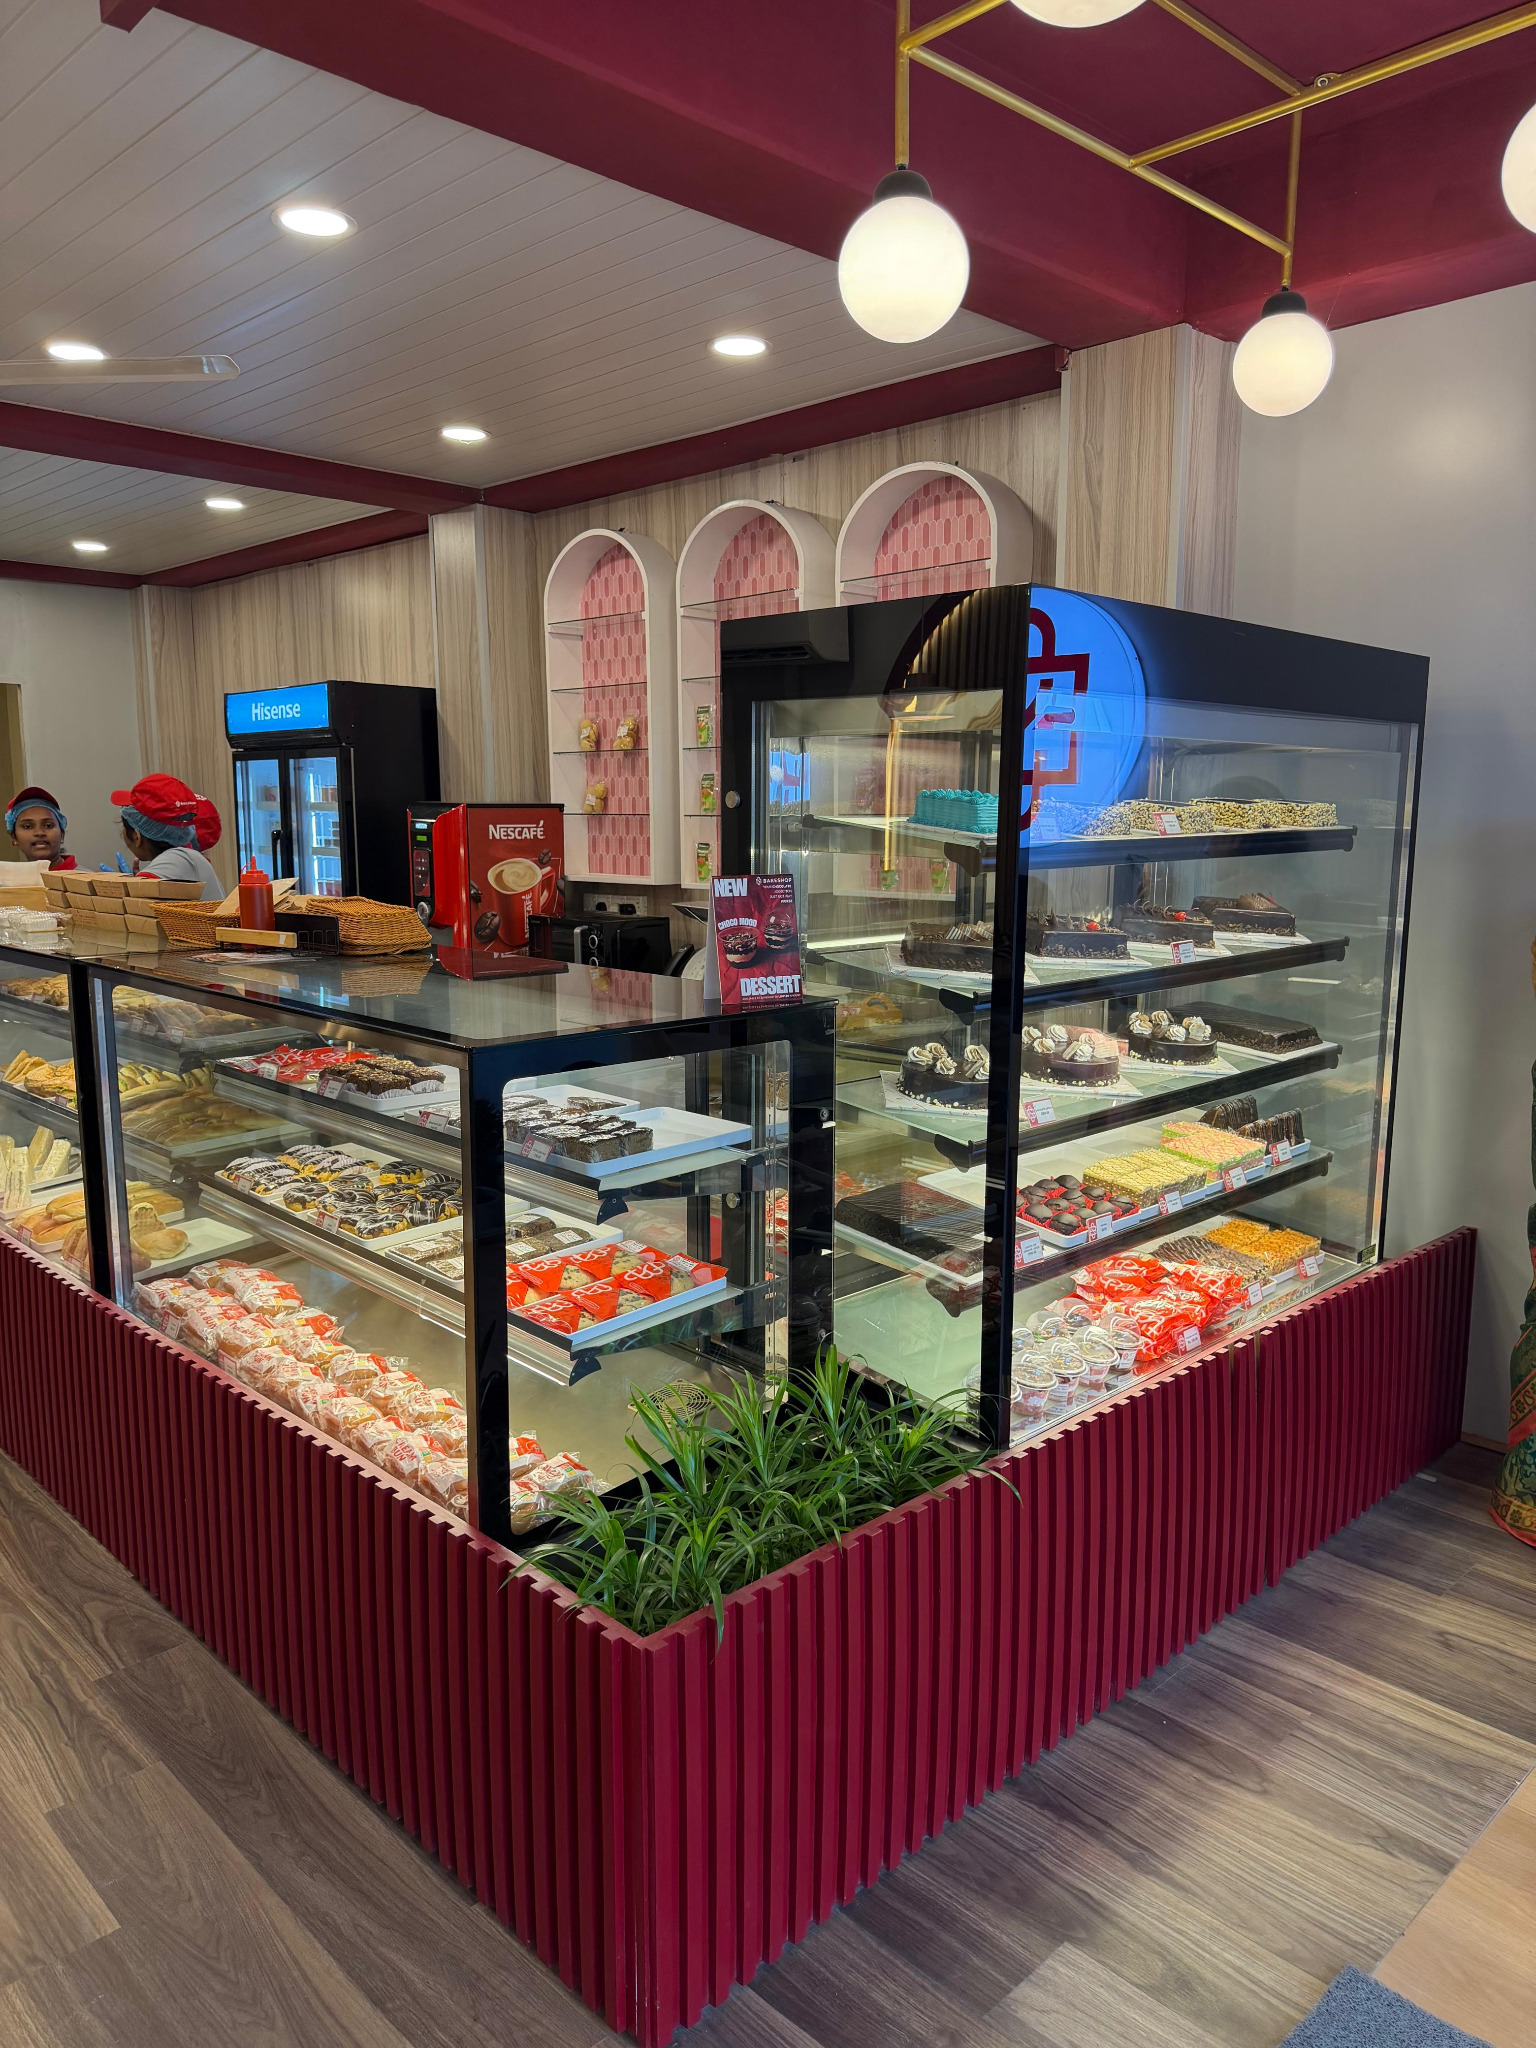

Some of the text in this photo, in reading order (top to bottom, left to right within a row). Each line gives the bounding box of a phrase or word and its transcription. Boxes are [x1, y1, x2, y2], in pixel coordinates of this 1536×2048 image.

[251, 702, 301, 722] Hisense
[488, 820, 545, 840] NESCAFÉ
[713, 878, 748, 897] NEW
[717, 917, 738, 930] CHOCO
[740, 974, 801, 997] DESSERT
[395, 1437, 417, 1461] CREAM
